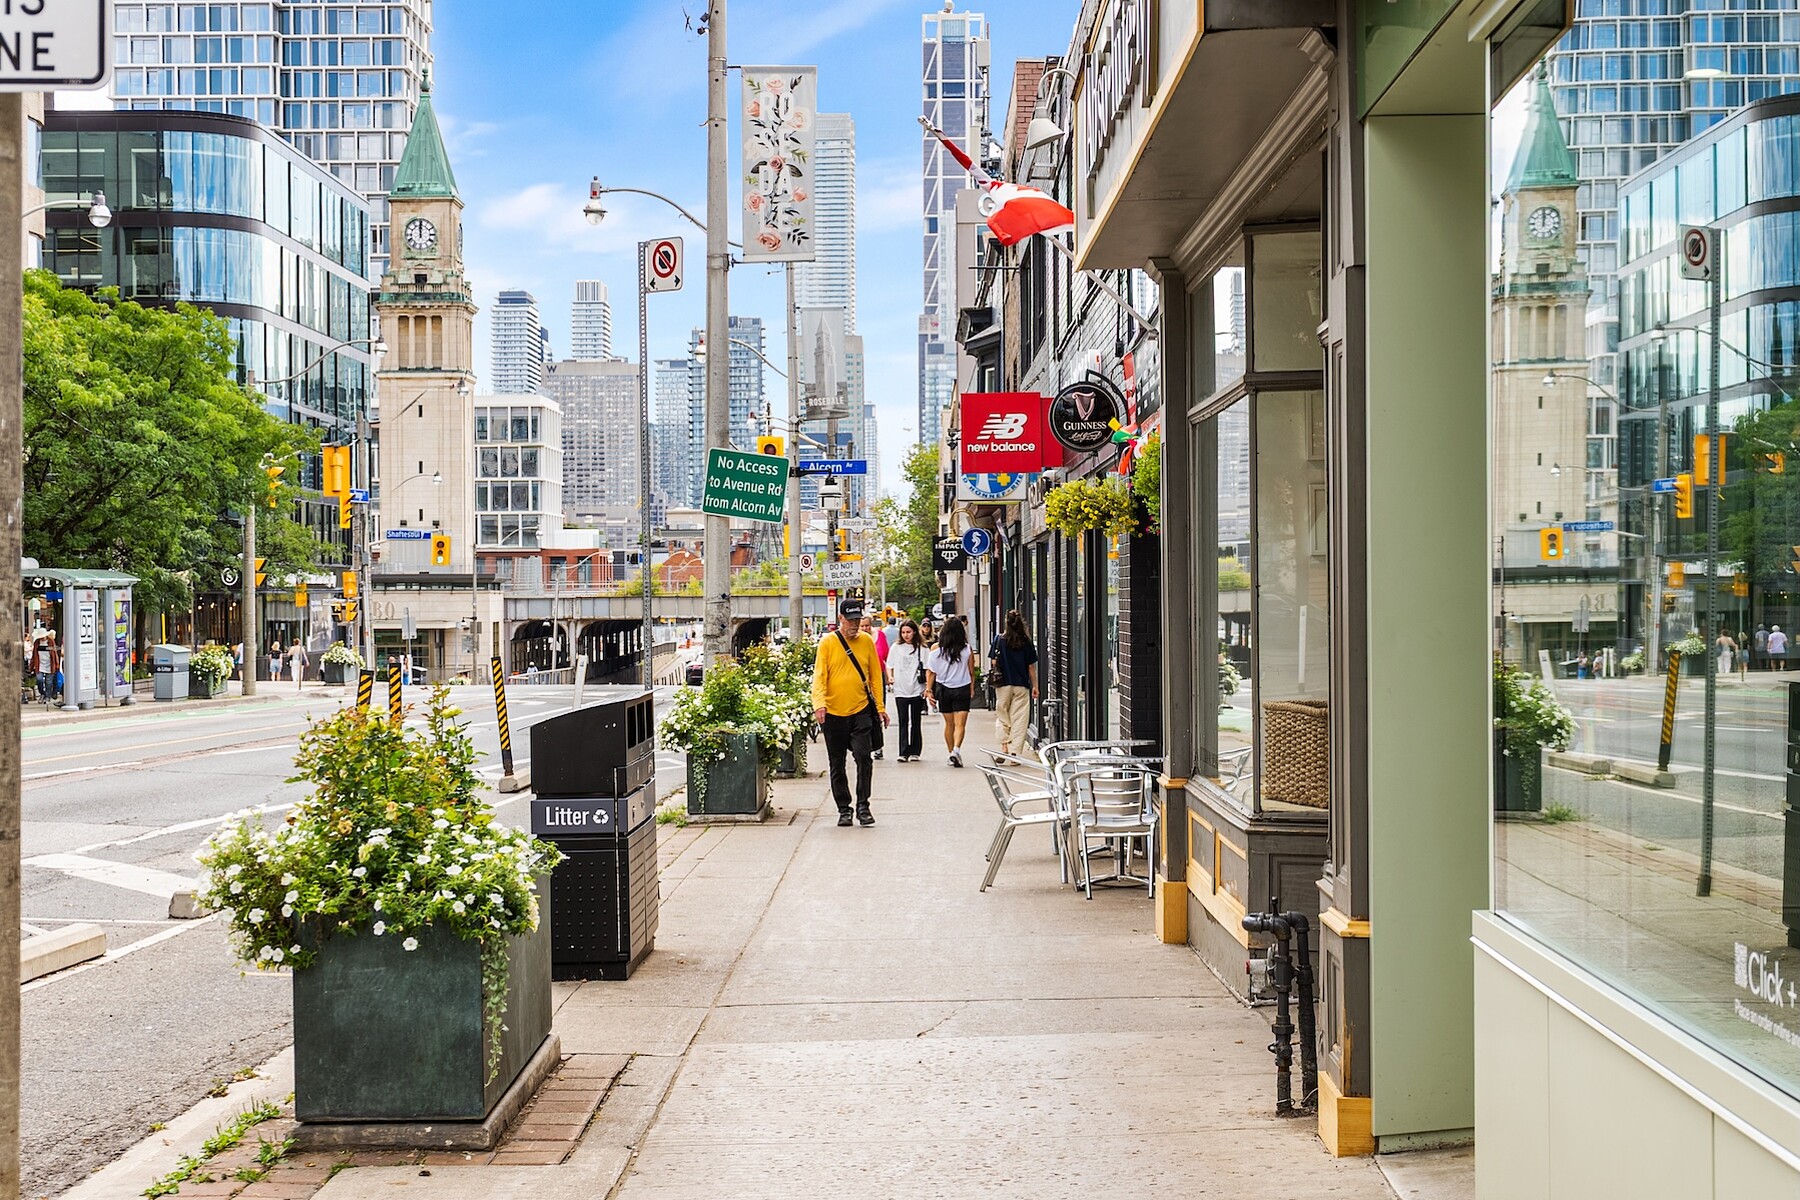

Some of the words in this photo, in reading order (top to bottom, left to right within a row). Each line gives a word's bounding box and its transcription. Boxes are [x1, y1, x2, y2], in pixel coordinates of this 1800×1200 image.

[546, 364, 557, 373] W
[808, 397, 844, 407] ROSEDALE
[1063, 421, 1107, 431] GUINNESS
[967, 443, 989, 452] new
[990, 441, 1036, 452] balance
[717, 455, 734, 470] No
[736, 458, 779, 476] Access
[809, 462, 842, 473] Alcorn
[708, 475, 721, 488] to
[722, 477, 765, 494] Avenue
[767, 482, 782, 496] Rd
[705, 494, 729, 509] from
[730, 498, 765, 514] Alcorn
[767, 503, 781, 516] Av
[829, 563, 839, 571] DO
[831, 571, 854, 579] BLOCK
[825, 579, 862, 588] INTERSECTION
[545, 806, 590, 826] Litter
[1748, 951, 1784, 1009] Click
